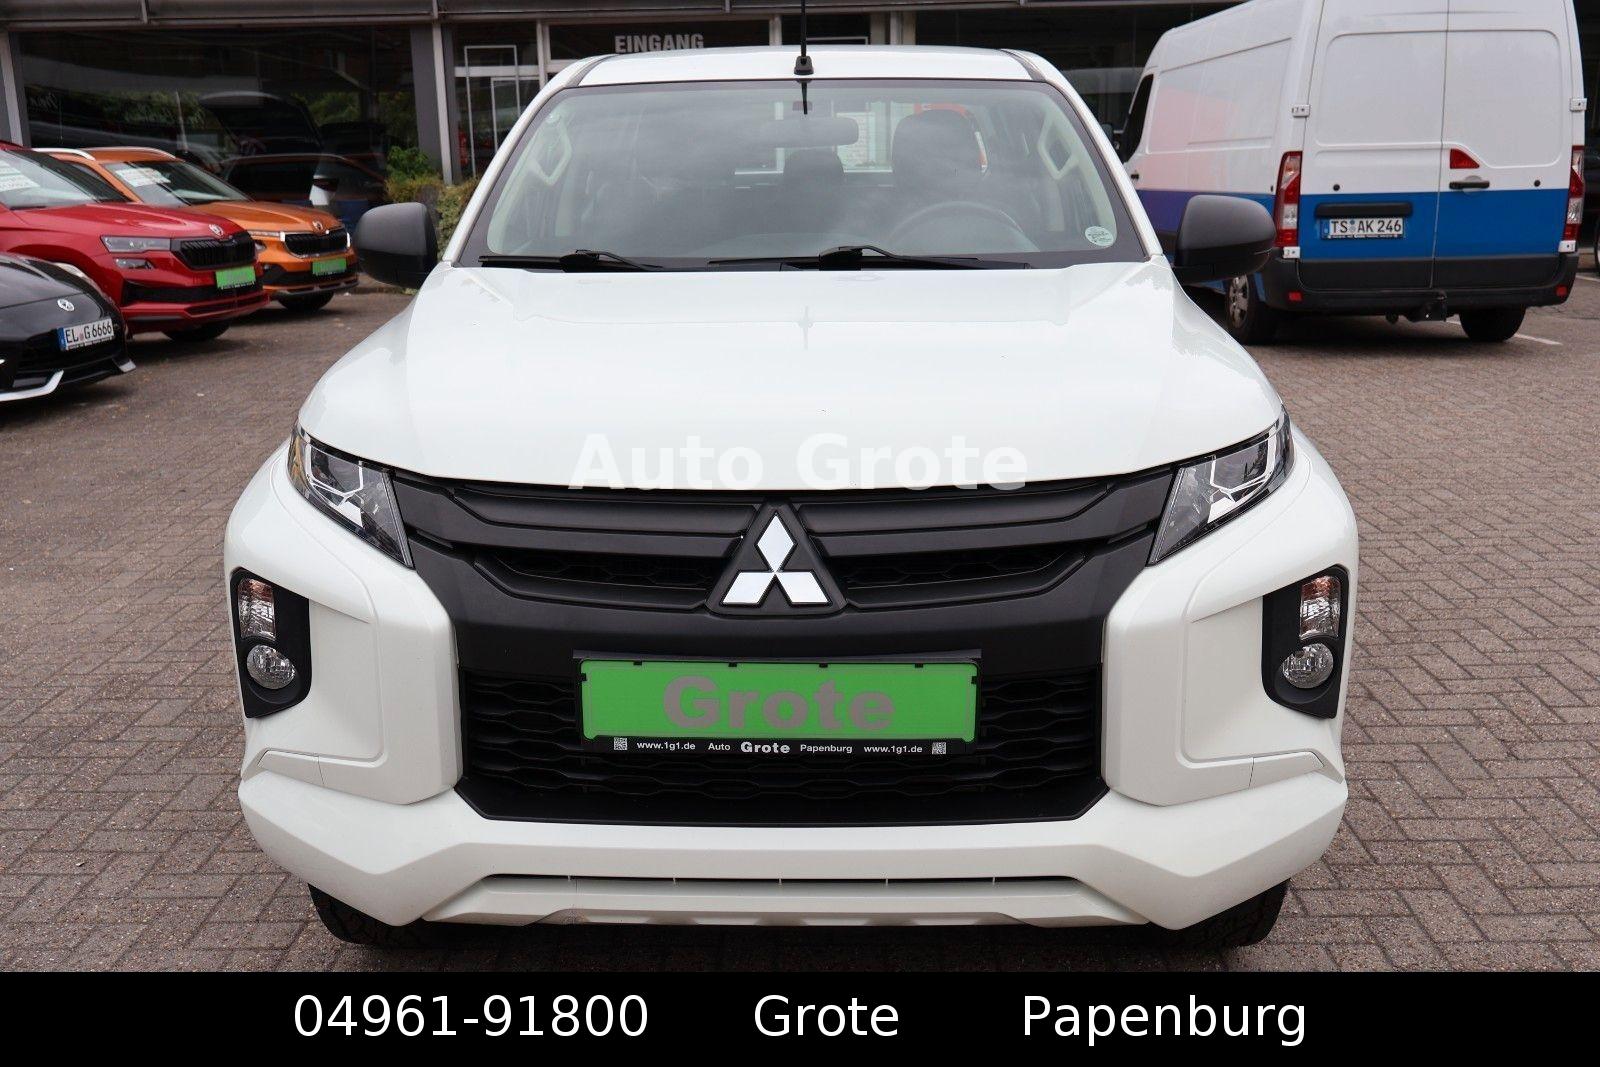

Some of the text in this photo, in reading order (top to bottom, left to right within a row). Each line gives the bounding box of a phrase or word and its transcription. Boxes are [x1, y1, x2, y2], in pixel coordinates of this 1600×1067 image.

[614, 33, 704, 54] EINGANG
[1331, 219, 1402, 234] TS AK 246
[65, 328, 79, 343] EL
[663, 676, 895, 731] Grote
[636, 741, 923, 755] www.1g1.de Auto Grote Papenburg www.1g1.de
